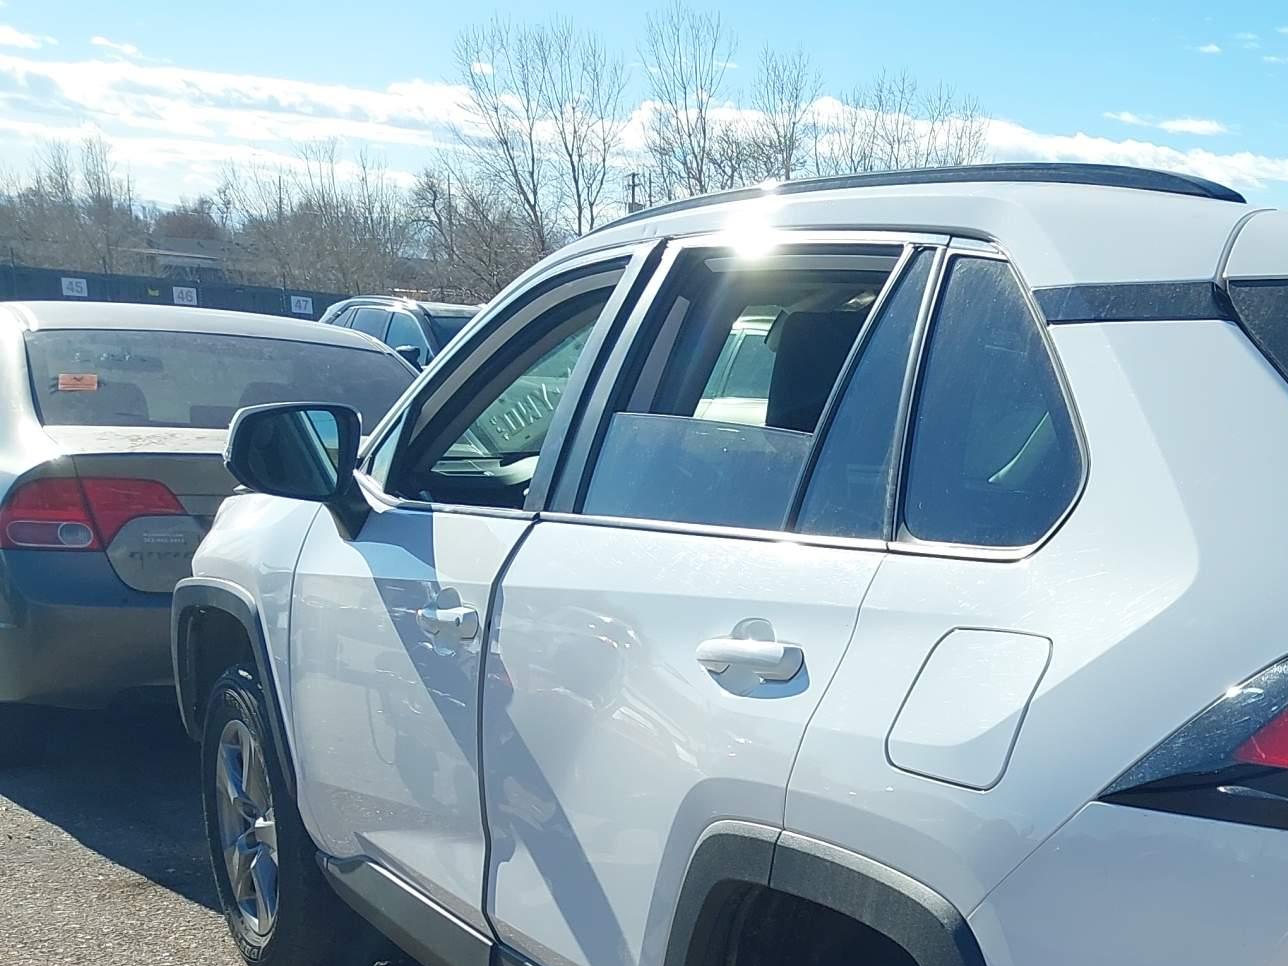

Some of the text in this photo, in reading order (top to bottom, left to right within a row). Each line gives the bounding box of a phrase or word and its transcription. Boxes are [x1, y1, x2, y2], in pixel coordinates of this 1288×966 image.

[66, 281, 85, 295] 45
[176, 290, 195, 303] 46
[295, 299, 311, 312] 47
